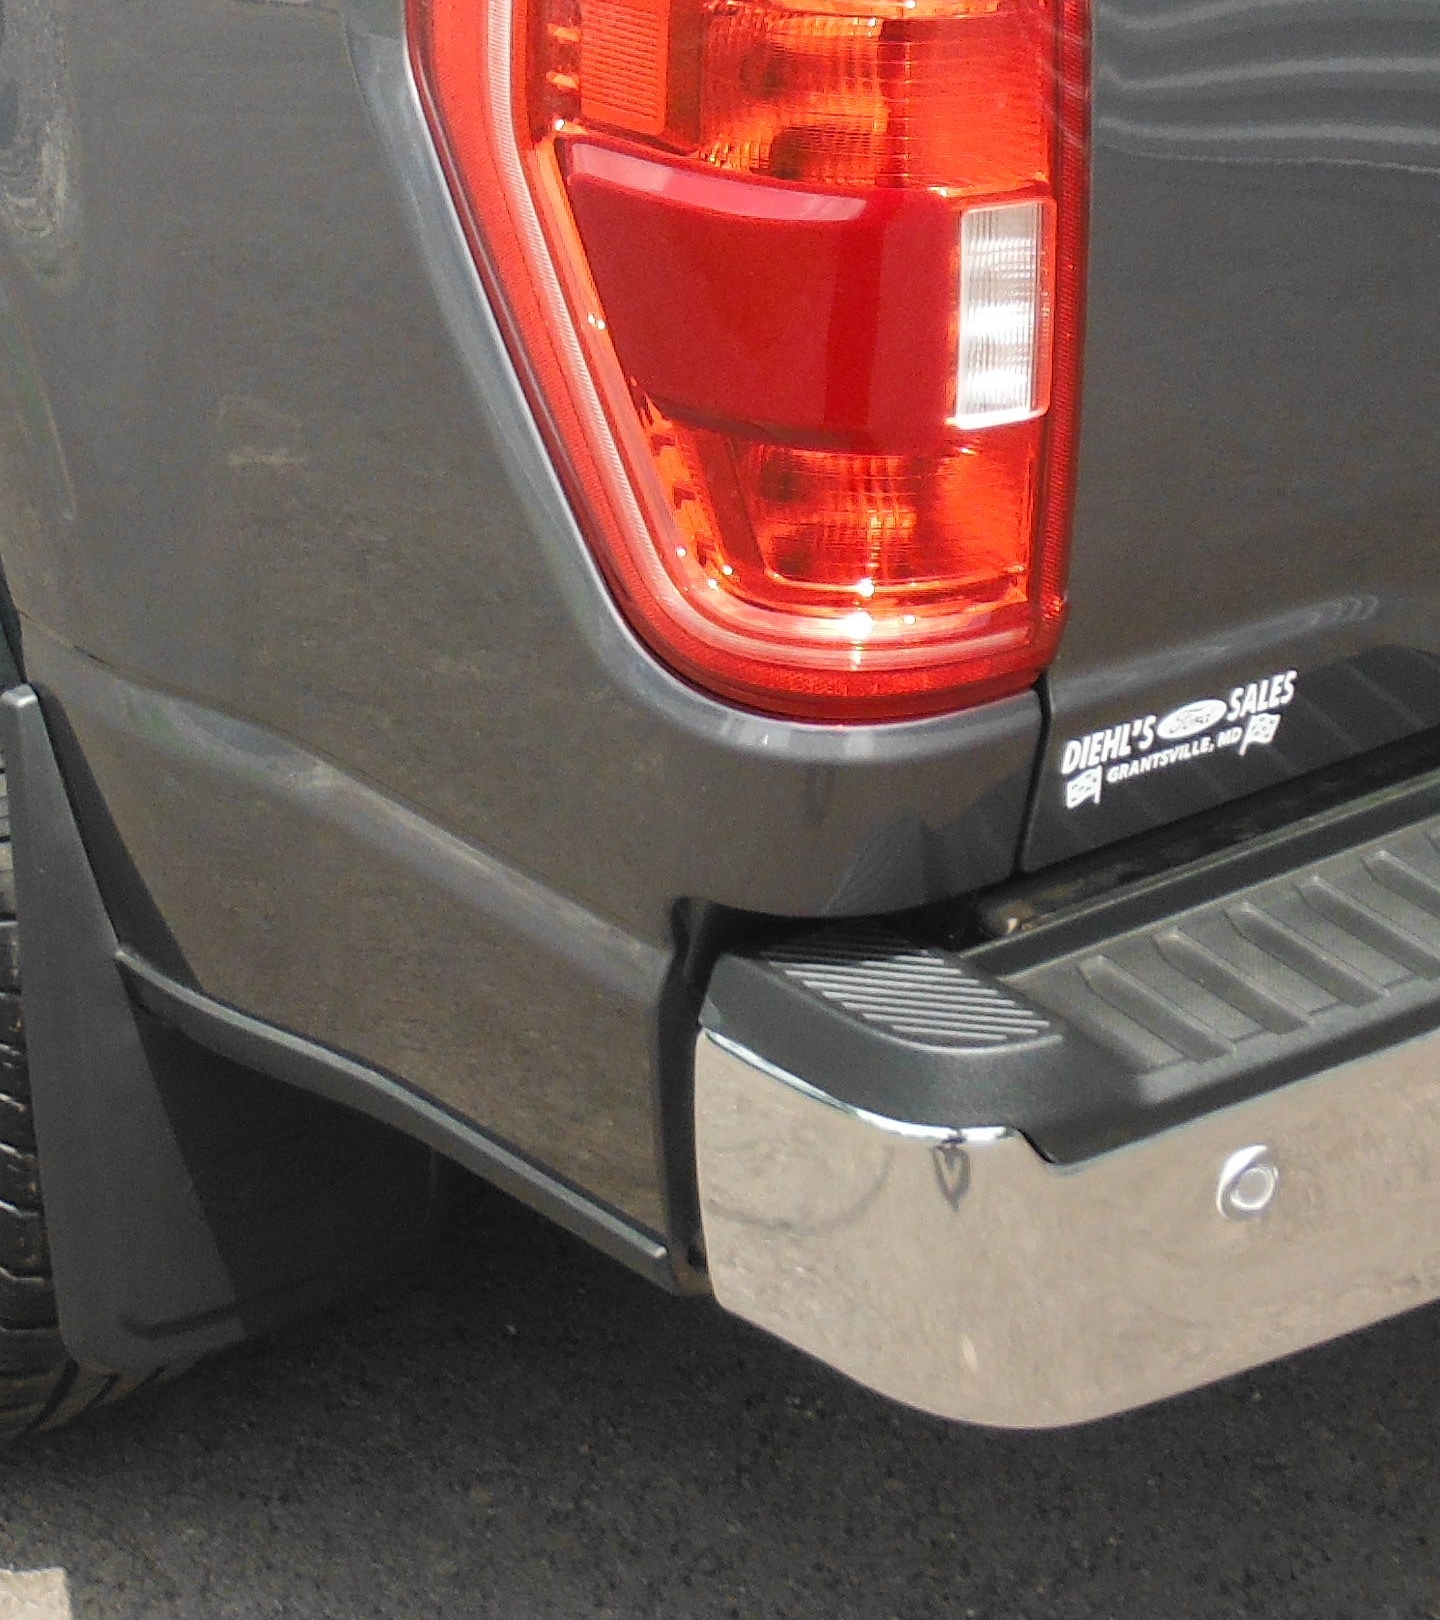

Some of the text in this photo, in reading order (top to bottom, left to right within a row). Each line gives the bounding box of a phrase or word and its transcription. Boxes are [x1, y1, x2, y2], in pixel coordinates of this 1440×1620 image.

[1061, 714, 1157, 775] DIEHL'S
[1226, 670, 1298, 721] SALES
[1106, 726, 1243, 783] GRANTSVILLE, MD
